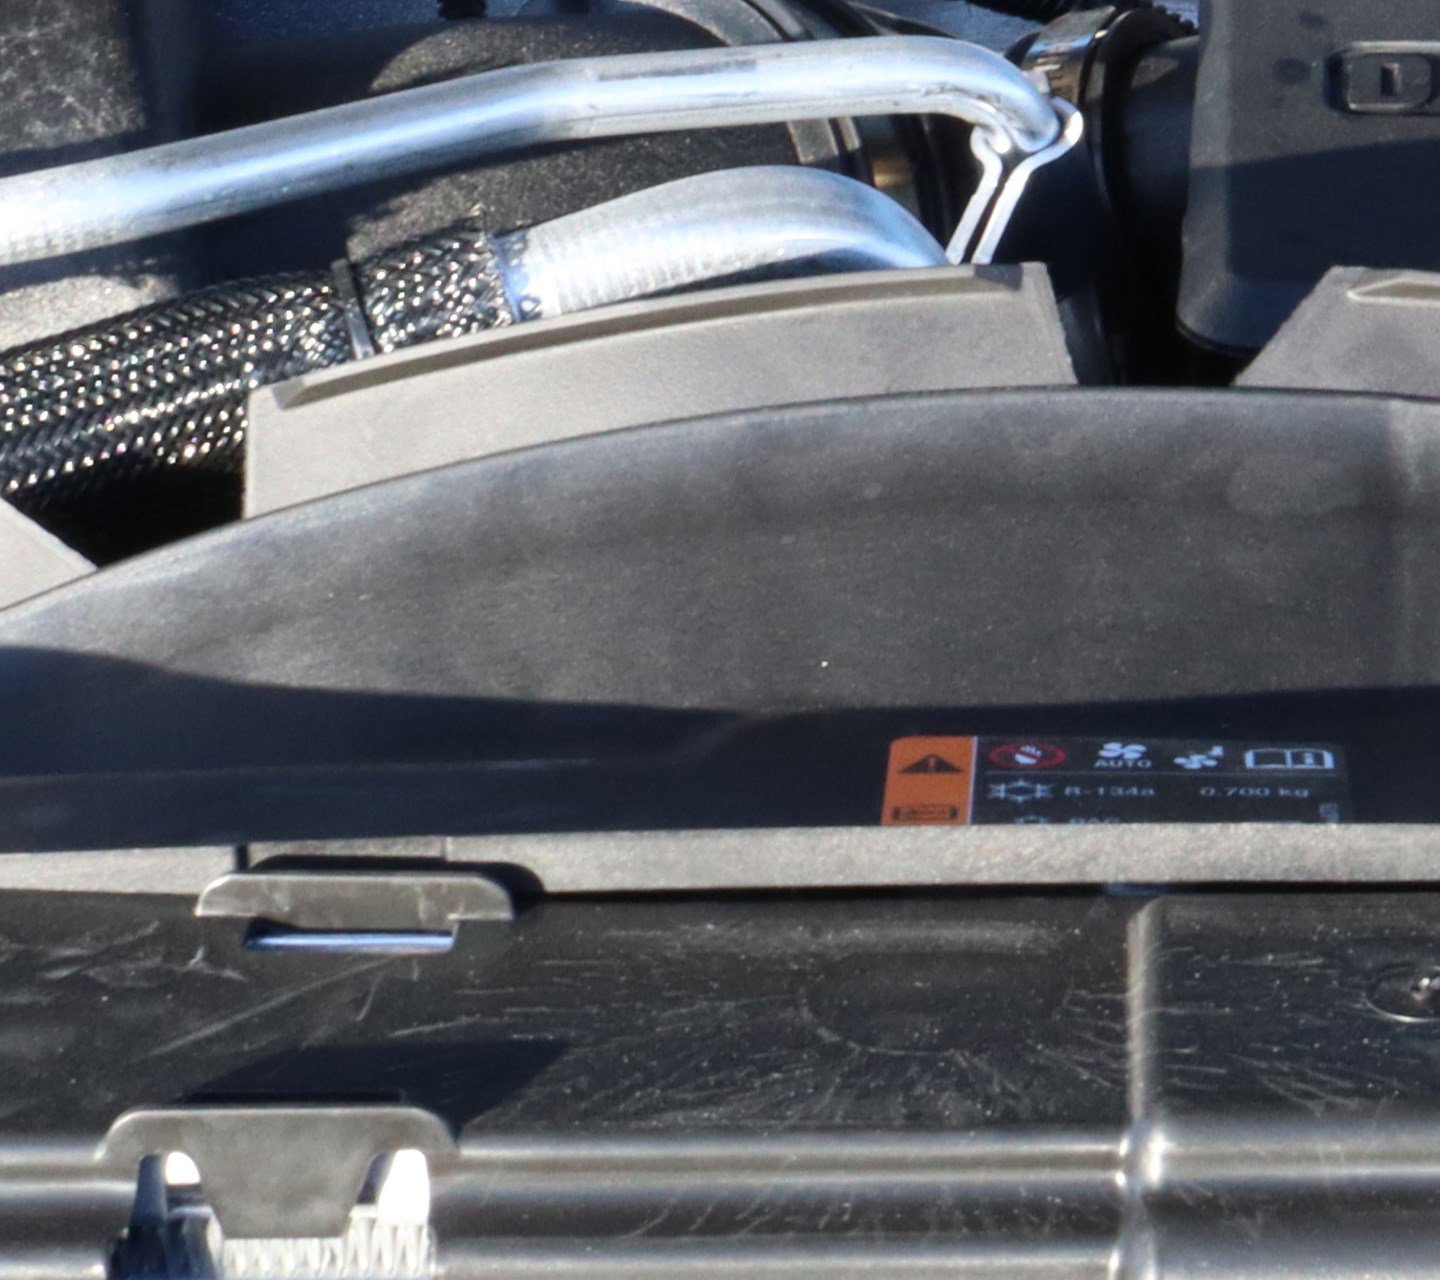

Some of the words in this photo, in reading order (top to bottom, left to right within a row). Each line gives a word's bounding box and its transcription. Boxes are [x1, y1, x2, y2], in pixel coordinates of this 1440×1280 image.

[1093, 759, 1152, 769] AUTO
[1064, 786, 1156, 797] R-134a
[1278, 787, 1310, 799] kg
